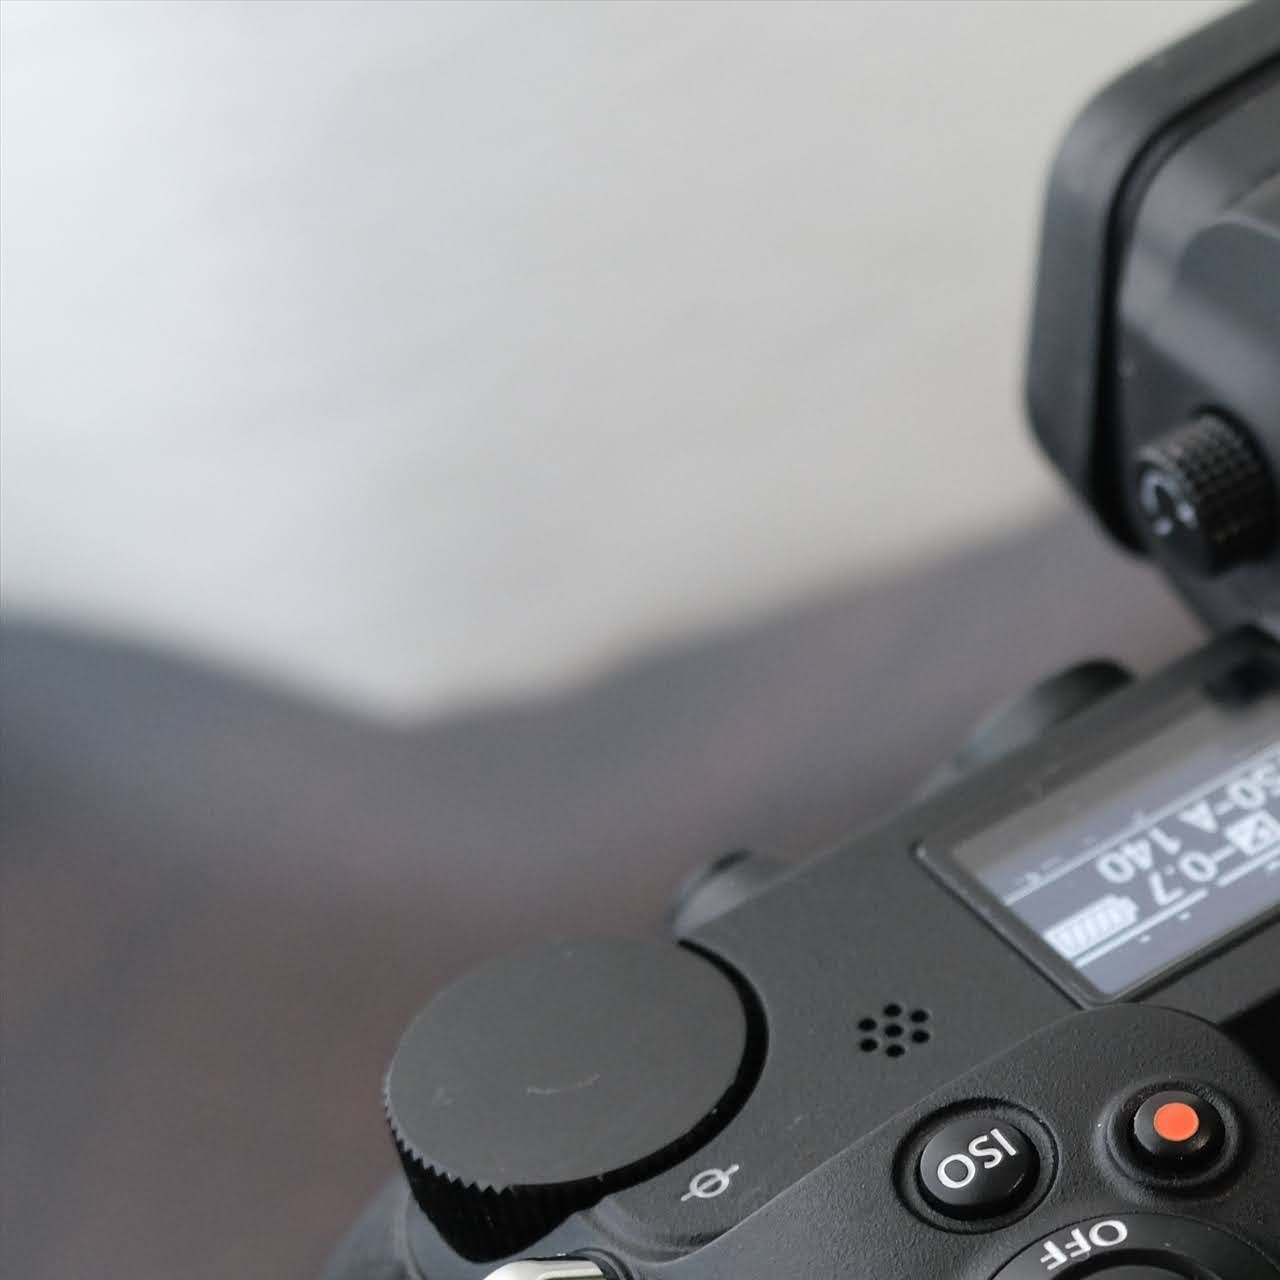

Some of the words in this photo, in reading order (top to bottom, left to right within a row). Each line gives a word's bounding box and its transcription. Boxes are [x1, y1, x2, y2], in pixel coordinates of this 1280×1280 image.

[1097, 828, 1180, 883] 140
[937, 1128, 1017, 1189] ISO
[1040, 1220, 1128, 1270] OFF
